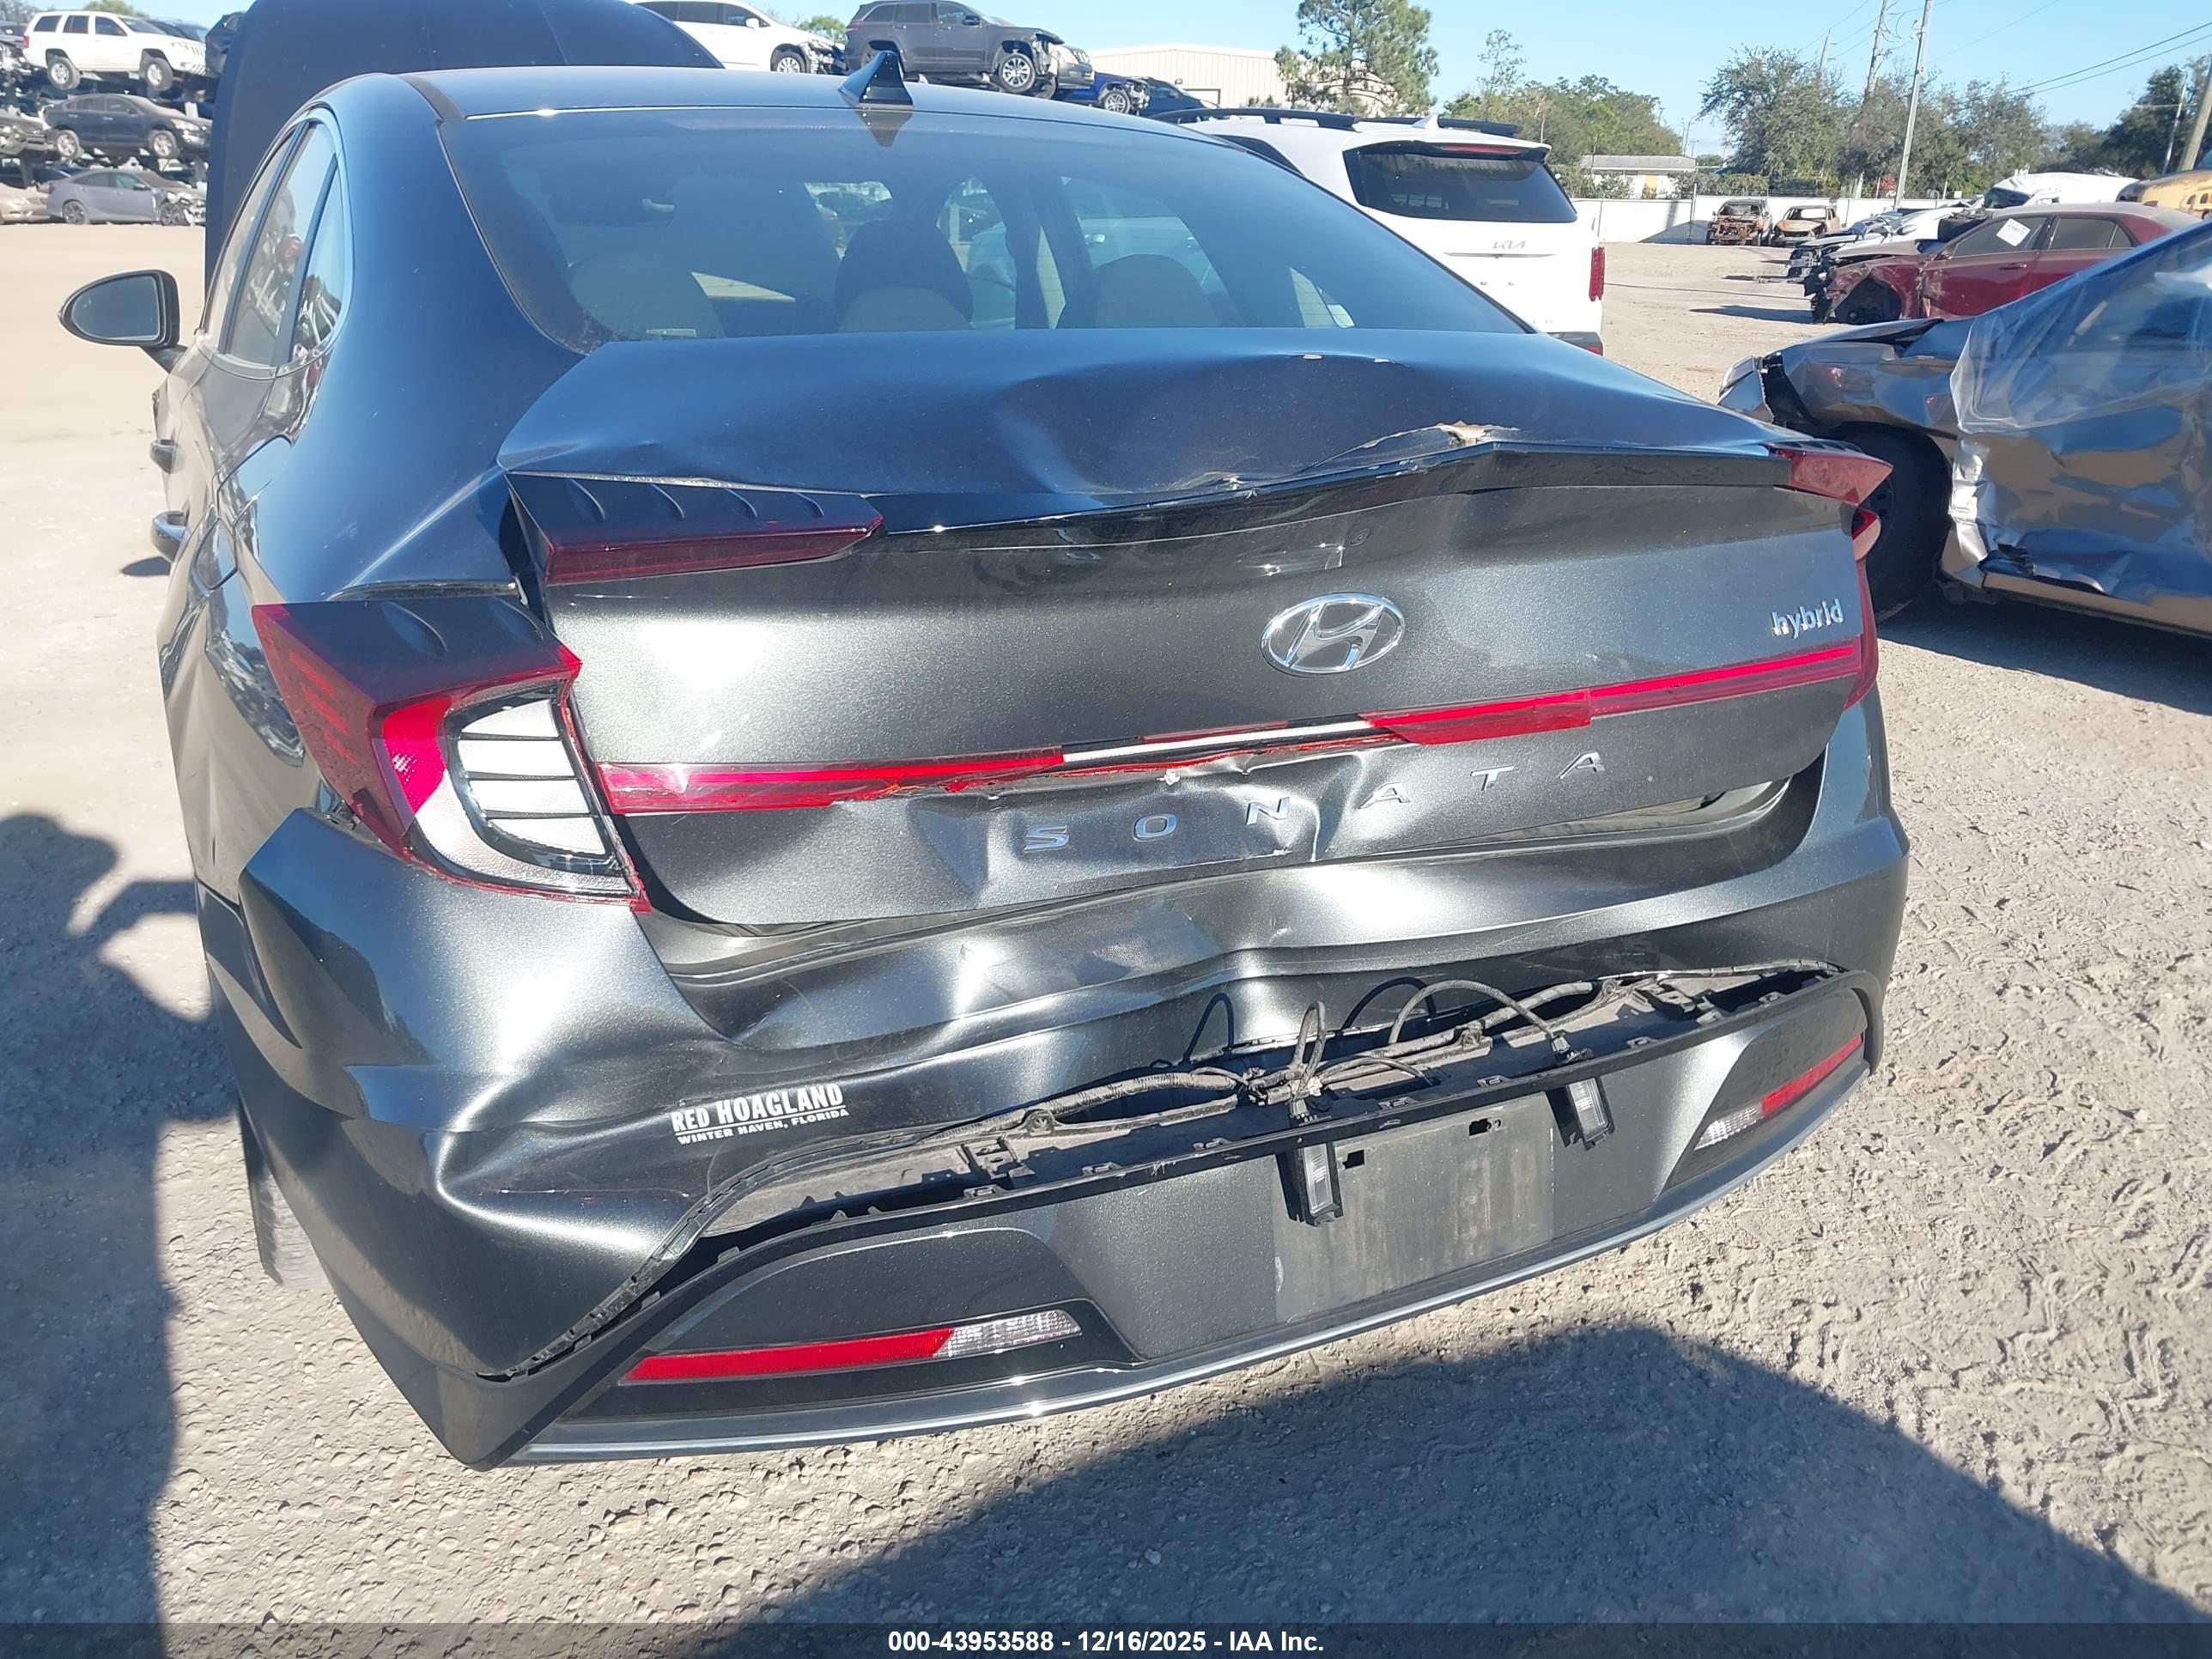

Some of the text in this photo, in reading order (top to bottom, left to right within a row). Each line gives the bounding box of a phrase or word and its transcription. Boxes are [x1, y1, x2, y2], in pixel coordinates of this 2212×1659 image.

[1492, 240, 1526, 249] KIA
[1771, 598, 1844, 639] hybrid
[1024, 750, 1606, 853] SONATA
[671, 1083, 844, 1133] RED HOAGLAND
[677, 1109, 849, 1145] WINTER HAVEN, FLORIDA
